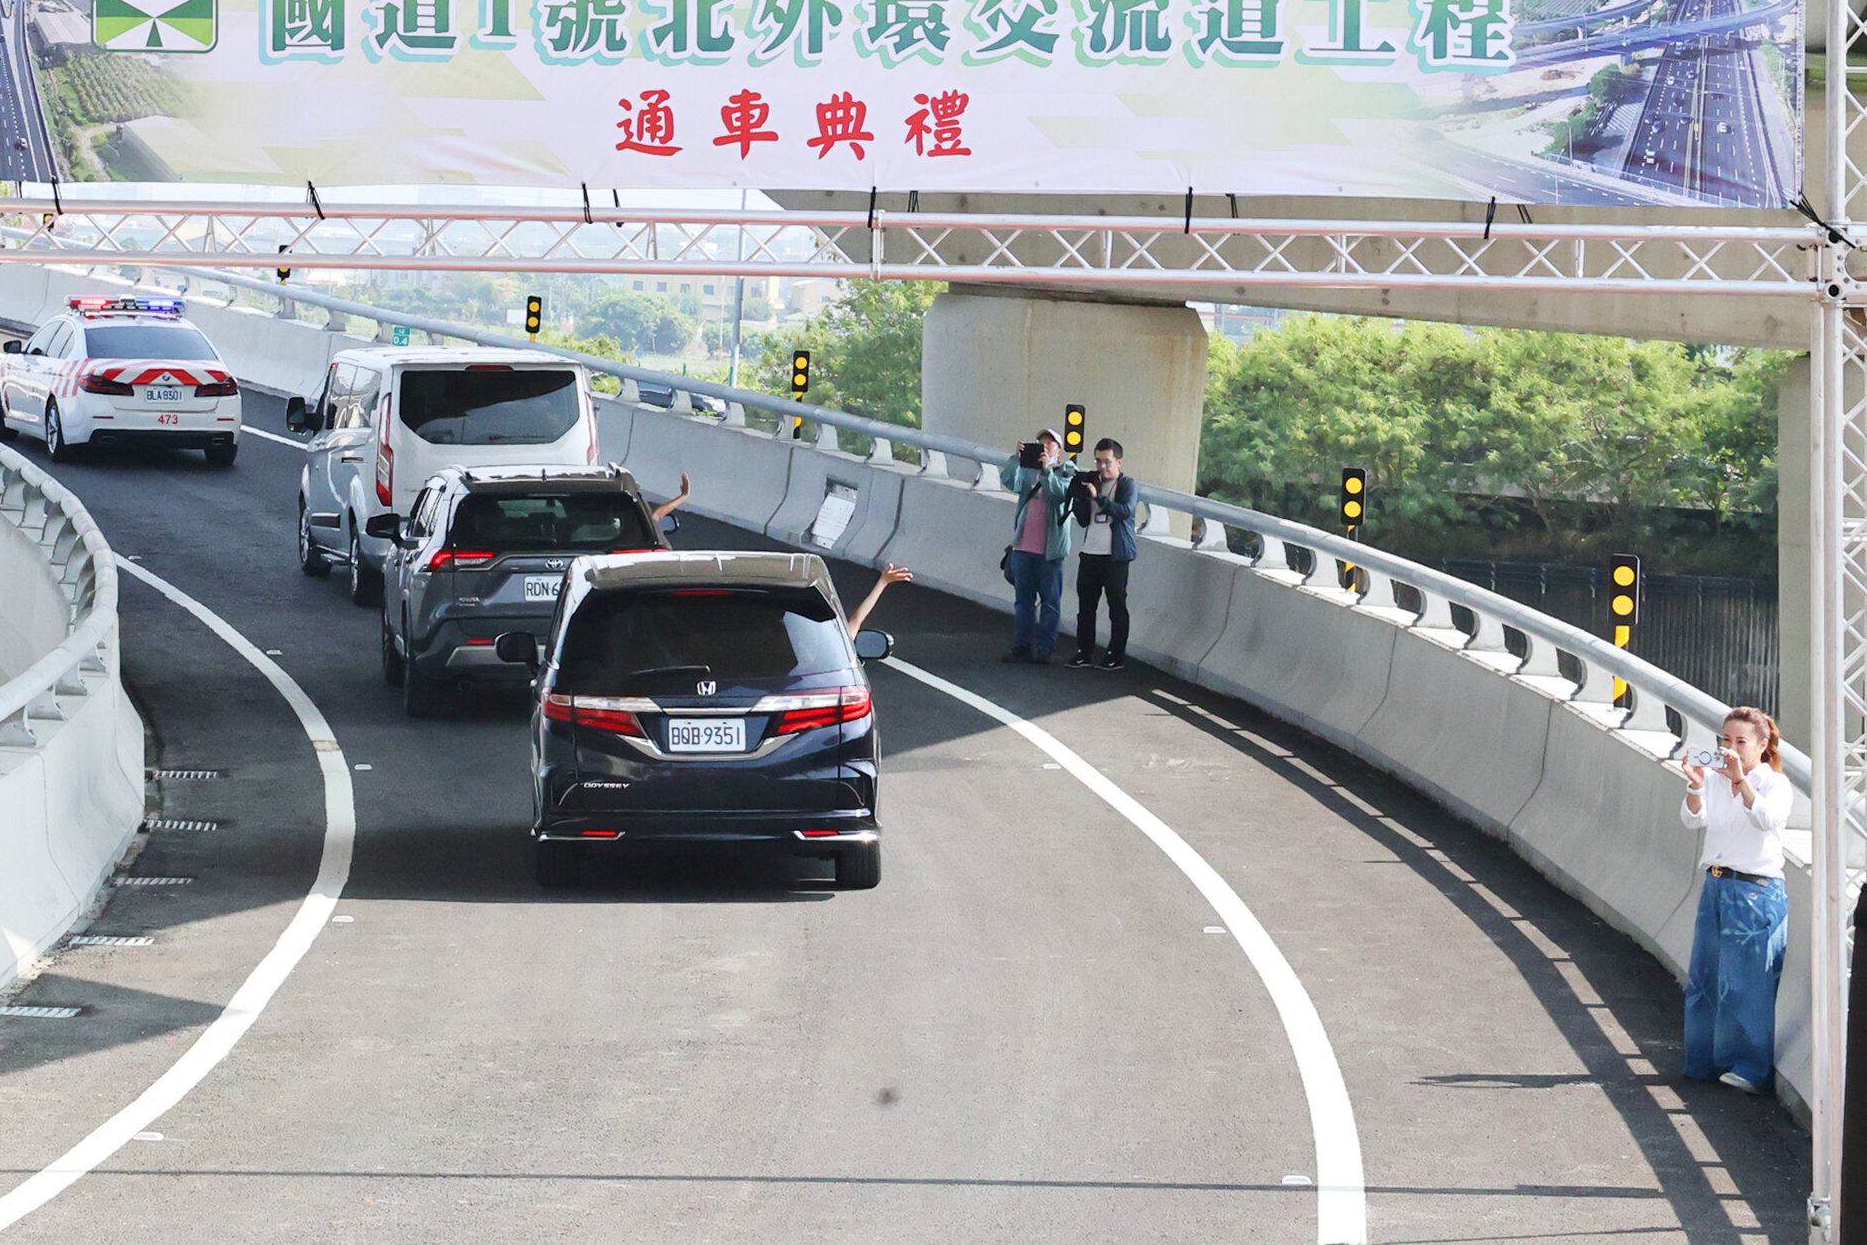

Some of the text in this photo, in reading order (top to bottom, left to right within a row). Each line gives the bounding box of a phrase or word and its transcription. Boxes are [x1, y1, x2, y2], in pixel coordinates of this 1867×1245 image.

[614, 88, 973, 160] 通車典禮
[157, 414, 179, 425] 473
